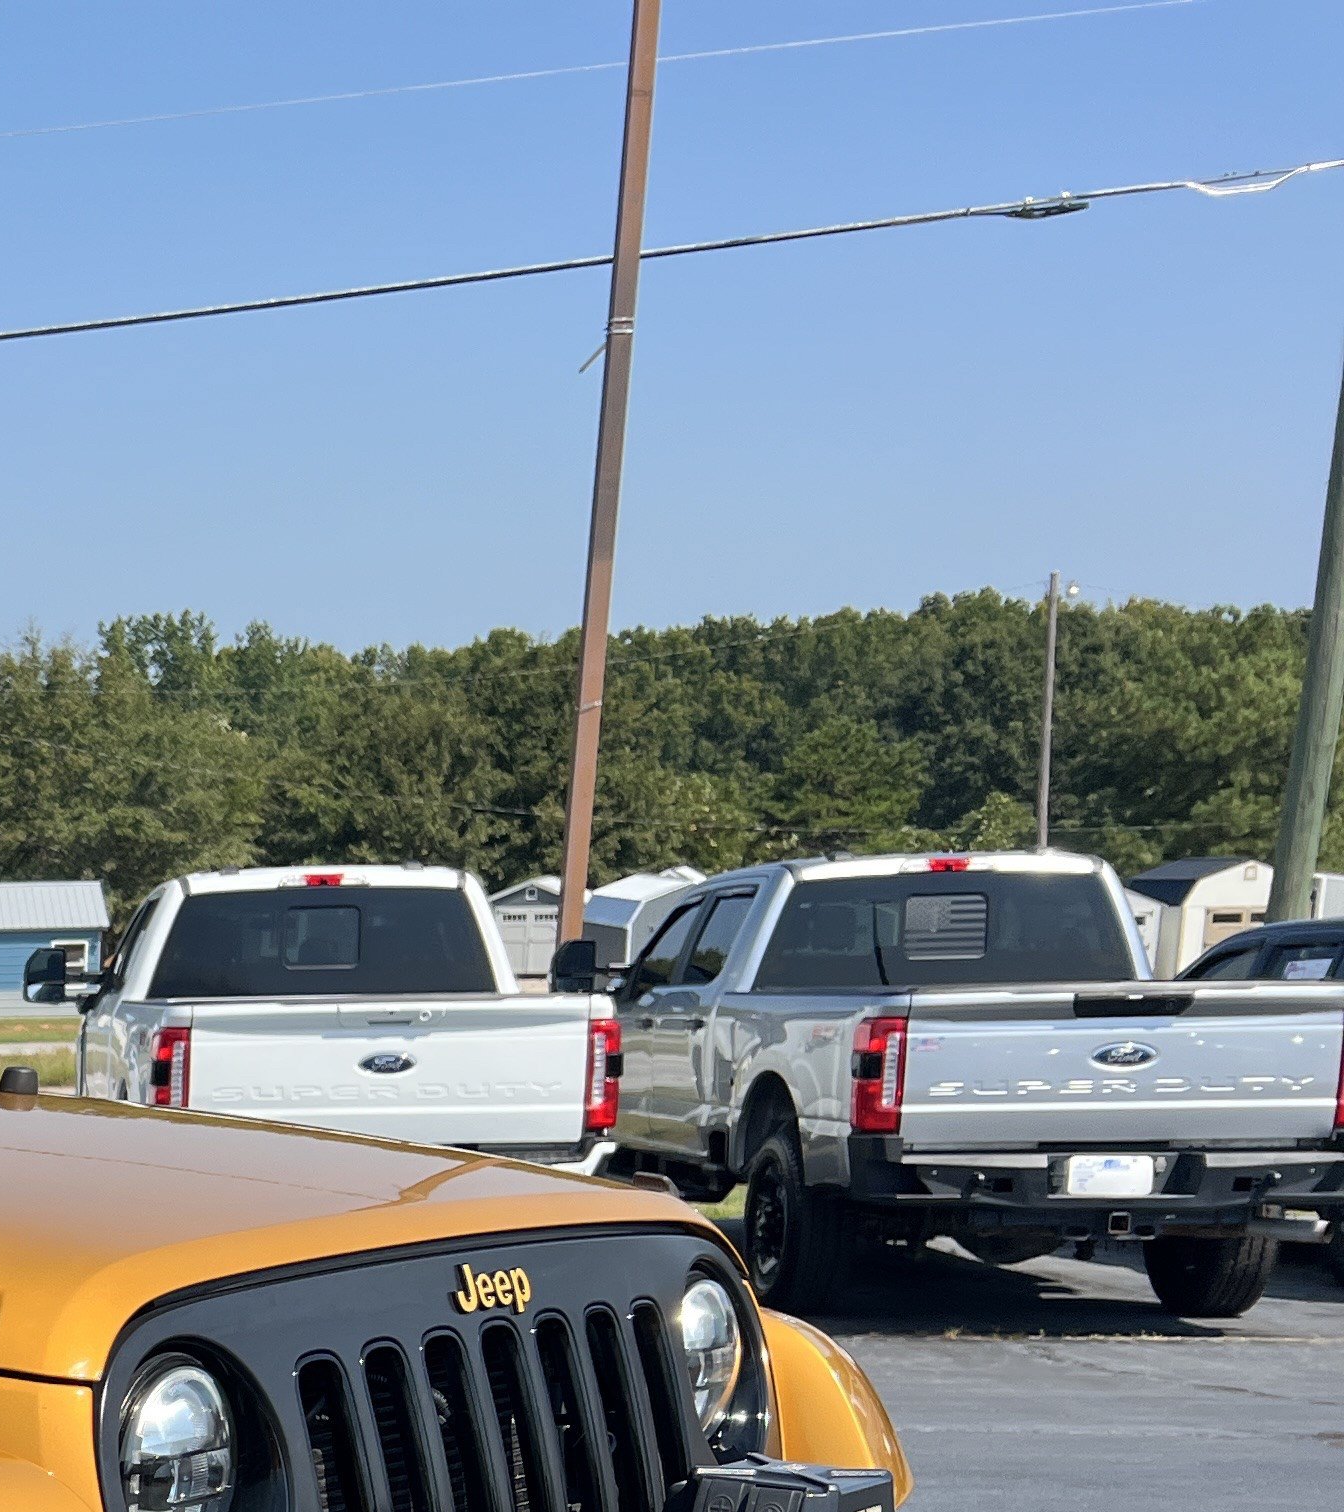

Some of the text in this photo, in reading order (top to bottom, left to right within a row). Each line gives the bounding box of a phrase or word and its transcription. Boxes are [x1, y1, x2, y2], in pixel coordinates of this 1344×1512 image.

[211, 1080, 563, 1102] SUPER DUTY
[928, 1075, 1316, 1097] SUPER DUTY
[454, 1263, 531, 1313] Jeep
